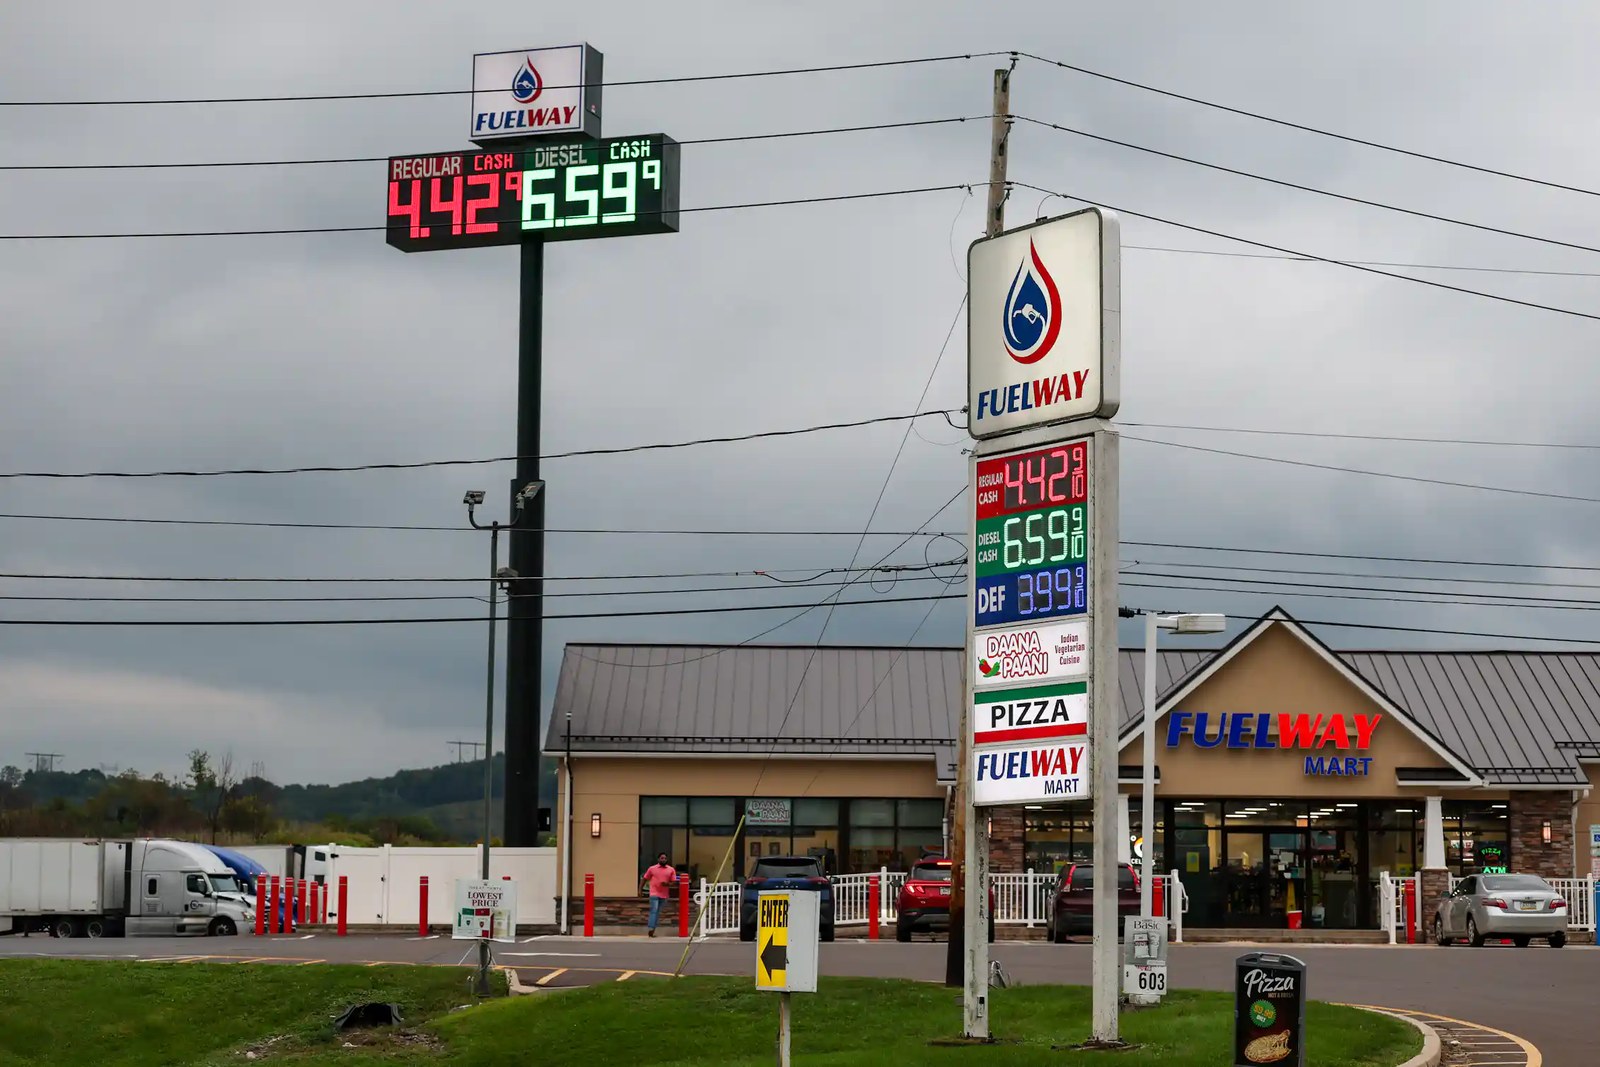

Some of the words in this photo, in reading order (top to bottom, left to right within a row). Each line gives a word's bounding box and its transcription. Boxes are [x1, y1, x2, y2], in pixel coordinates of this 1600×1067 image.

[475, 105, 577, 131] FUELWAY
[393, 156, 461, 180] REGULAR
[474, 154, 513, 171] CASH
[535, 144, 587, 168] DIESEL
[610, 140, 650, 160] CASH
[388, 173, 500, 239] 4.42
[521, 161, 636, 230] 6.59
[977, 368, 1090, 420] FUELWAY
[978, 471, 1004, 488] REGULAR
[1004, 450, 1069, 506] 4.42
[978, 490, 999, 505] CASH
[978, 531, 1001, 547] DIESEL
[1003, 510, 1069, 569] 6.59
[977, 549, 998, 564] CASH
[978, 585, 1006, 614] DEF
[1019, 568, 1072, 615] 3.99
[987, 631, 1042, 659] DAANA
[1054, 643, 1086, 655] Vegetarian
[1060, 634, 1079, 644] Indian
[1002, 651, 1049, 679] PAANI
[1059, 656, 1081, 666] Cuisine
[991, 698, 1070, 729] PIZZA
[1166, 712, 1382, 750] FUELWAY
[976, 746, 1085, 782] FUELWAY
[1304, 756, 1373, 777] MART
[1044, 778, 1080, 795] MART
[751, 800, 786, 811] DAANA
[1483, 866, 1506, 875] ATM
[467, 891, 503, 900] LOWEST
[761, 900, 788, 928] ENTER
[1134, 920, 1160, 930] Basic
[1244, 969, 1294, 998] Pizza
